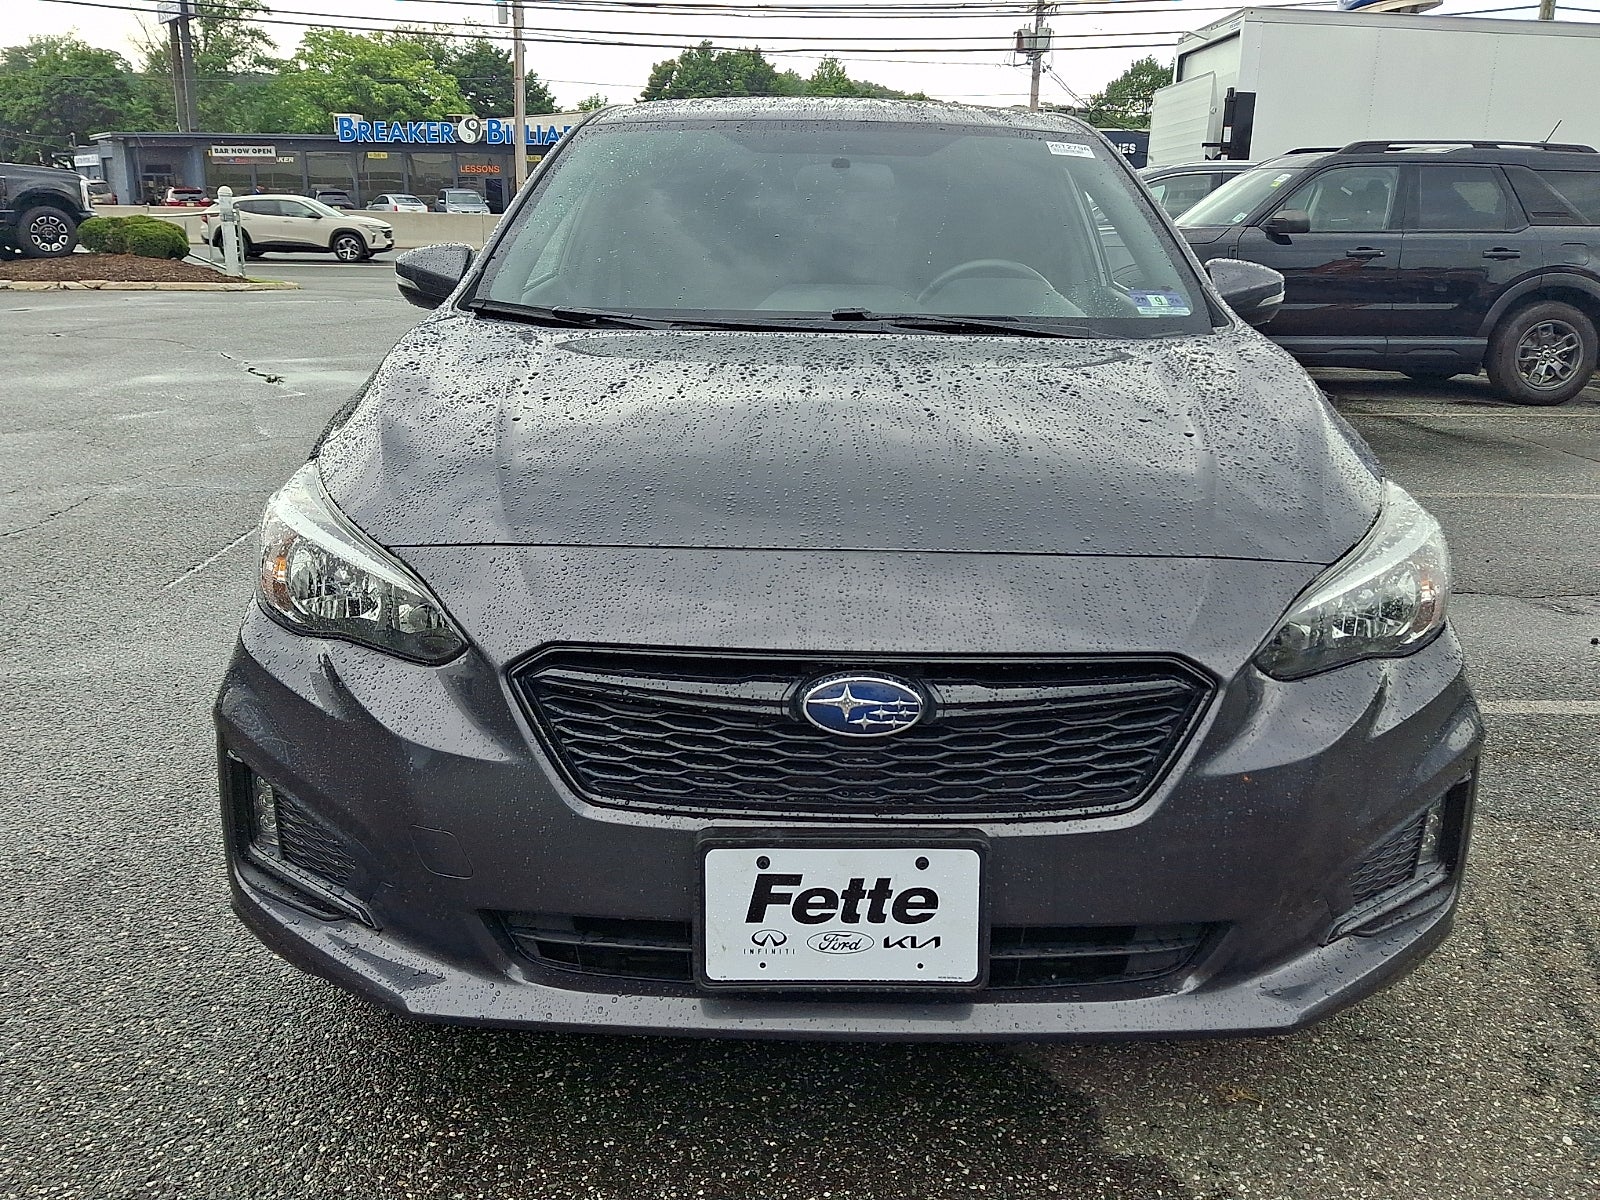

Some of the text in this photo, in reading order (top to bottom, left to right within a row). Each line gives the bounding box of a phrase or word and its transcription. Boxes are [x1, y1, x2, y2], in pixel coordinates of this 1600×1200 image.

[338, 117, 456, 144] BREAKER
[486, 118, 573, 146] BILIA
[460, 164, 500, 173] LESSONS
[1154, 296, 1164, 306] 9
[745, 873, 939, 925] Fette
[818, 932, 862, 951] Ford
